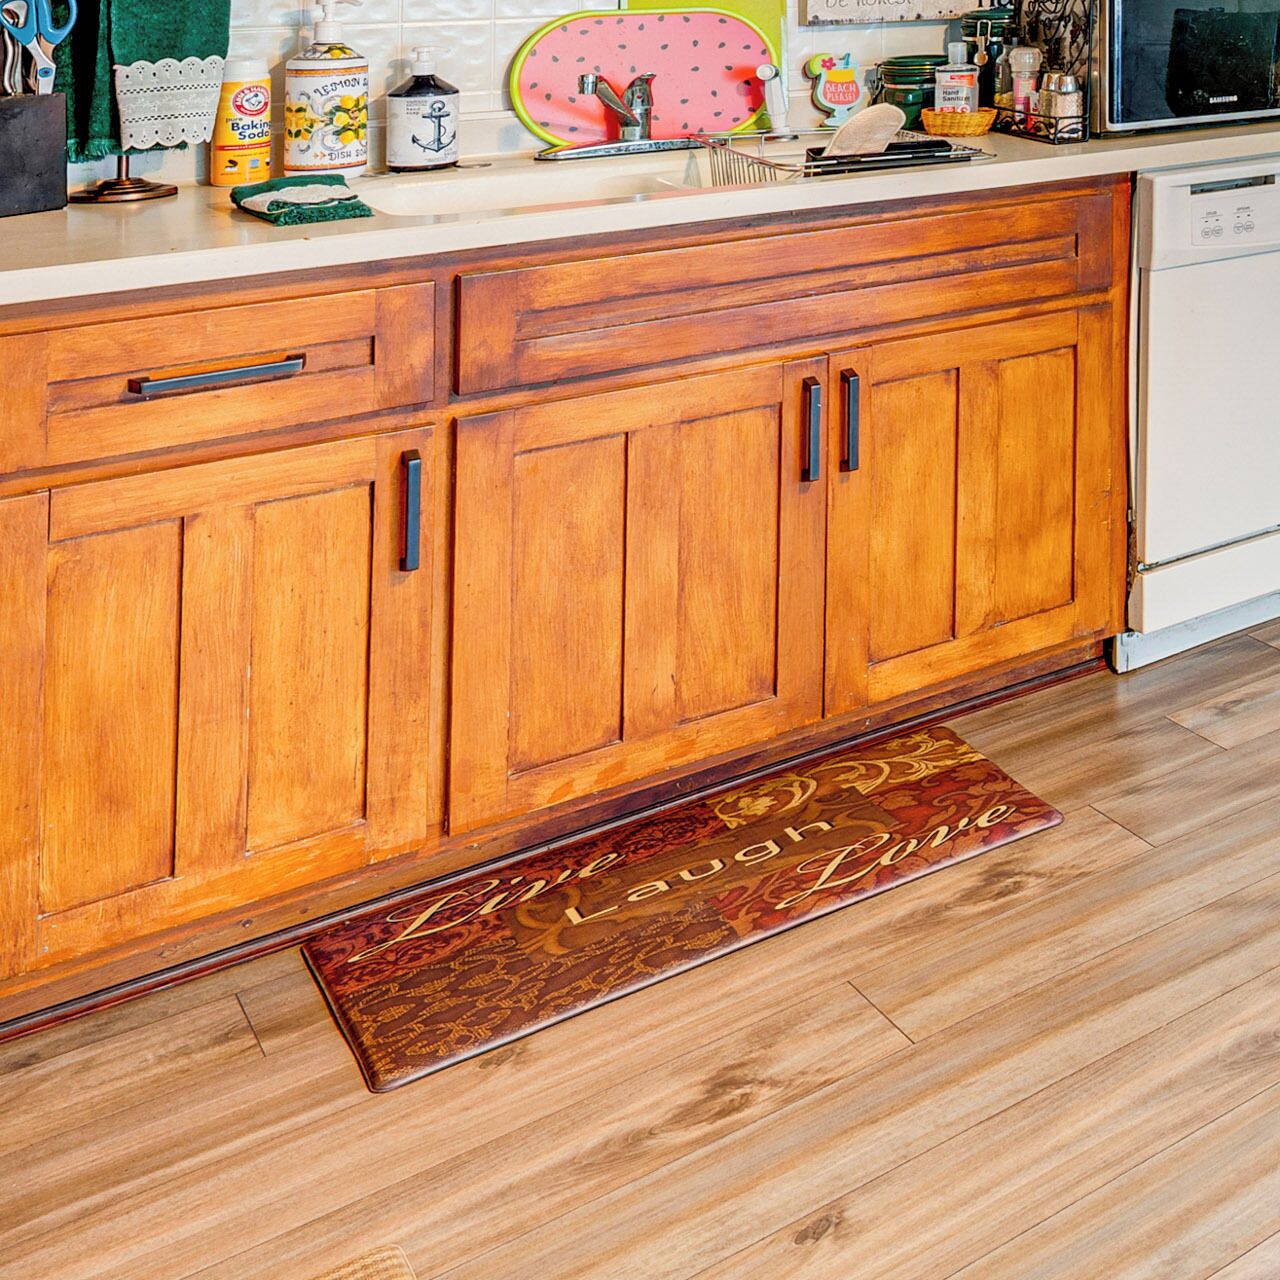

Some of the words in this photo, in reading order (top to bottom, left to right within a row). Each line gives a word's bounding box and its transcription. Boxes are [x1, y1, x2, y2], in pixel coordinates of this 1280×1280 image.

[314, 77, 360, 97] LEMON
[825, 83, 856, 92] BEACH
[348, 851, 626, 963] Live
[565, 820, 834, 926] Laugh
[775, 804, 1017, 910] Love
